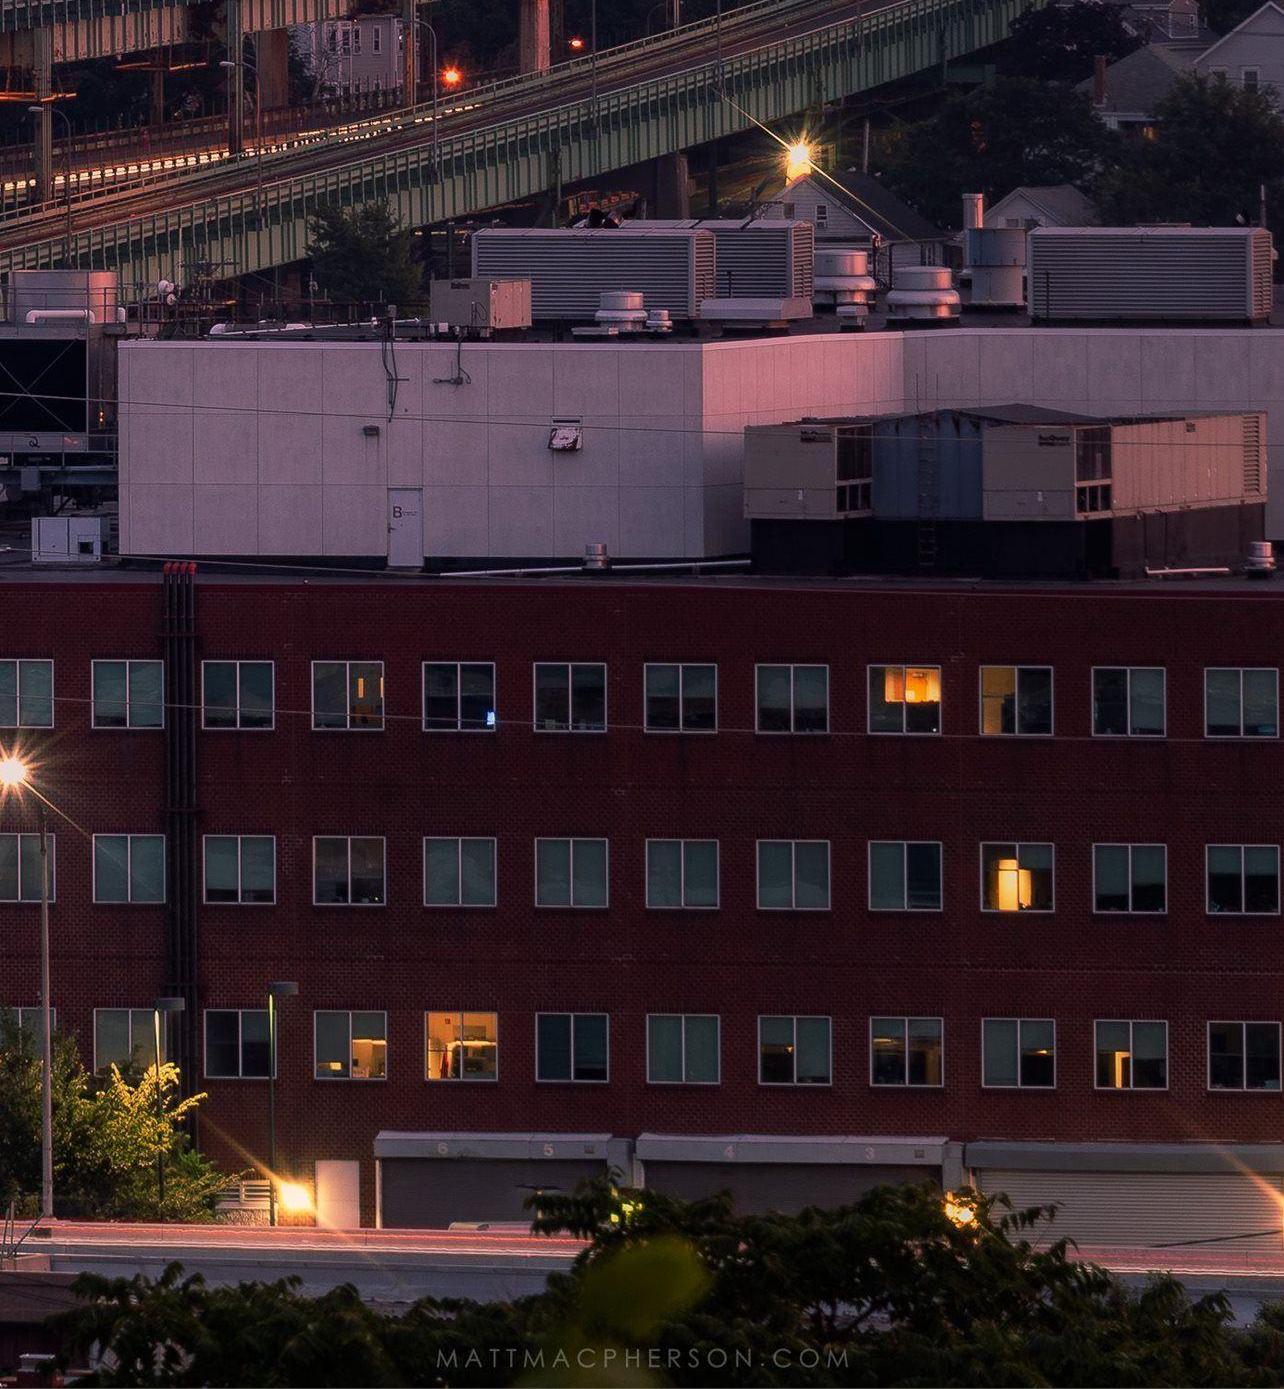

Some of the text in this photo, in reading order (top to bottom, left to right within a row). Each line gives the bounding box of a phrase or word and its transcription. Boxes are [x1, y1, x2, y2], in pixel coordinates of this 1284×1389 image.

[393, 506, 402, 518] B
[437, 1142, 554, 1156] 6 5
[864, 1146, 875, 1160] 3
